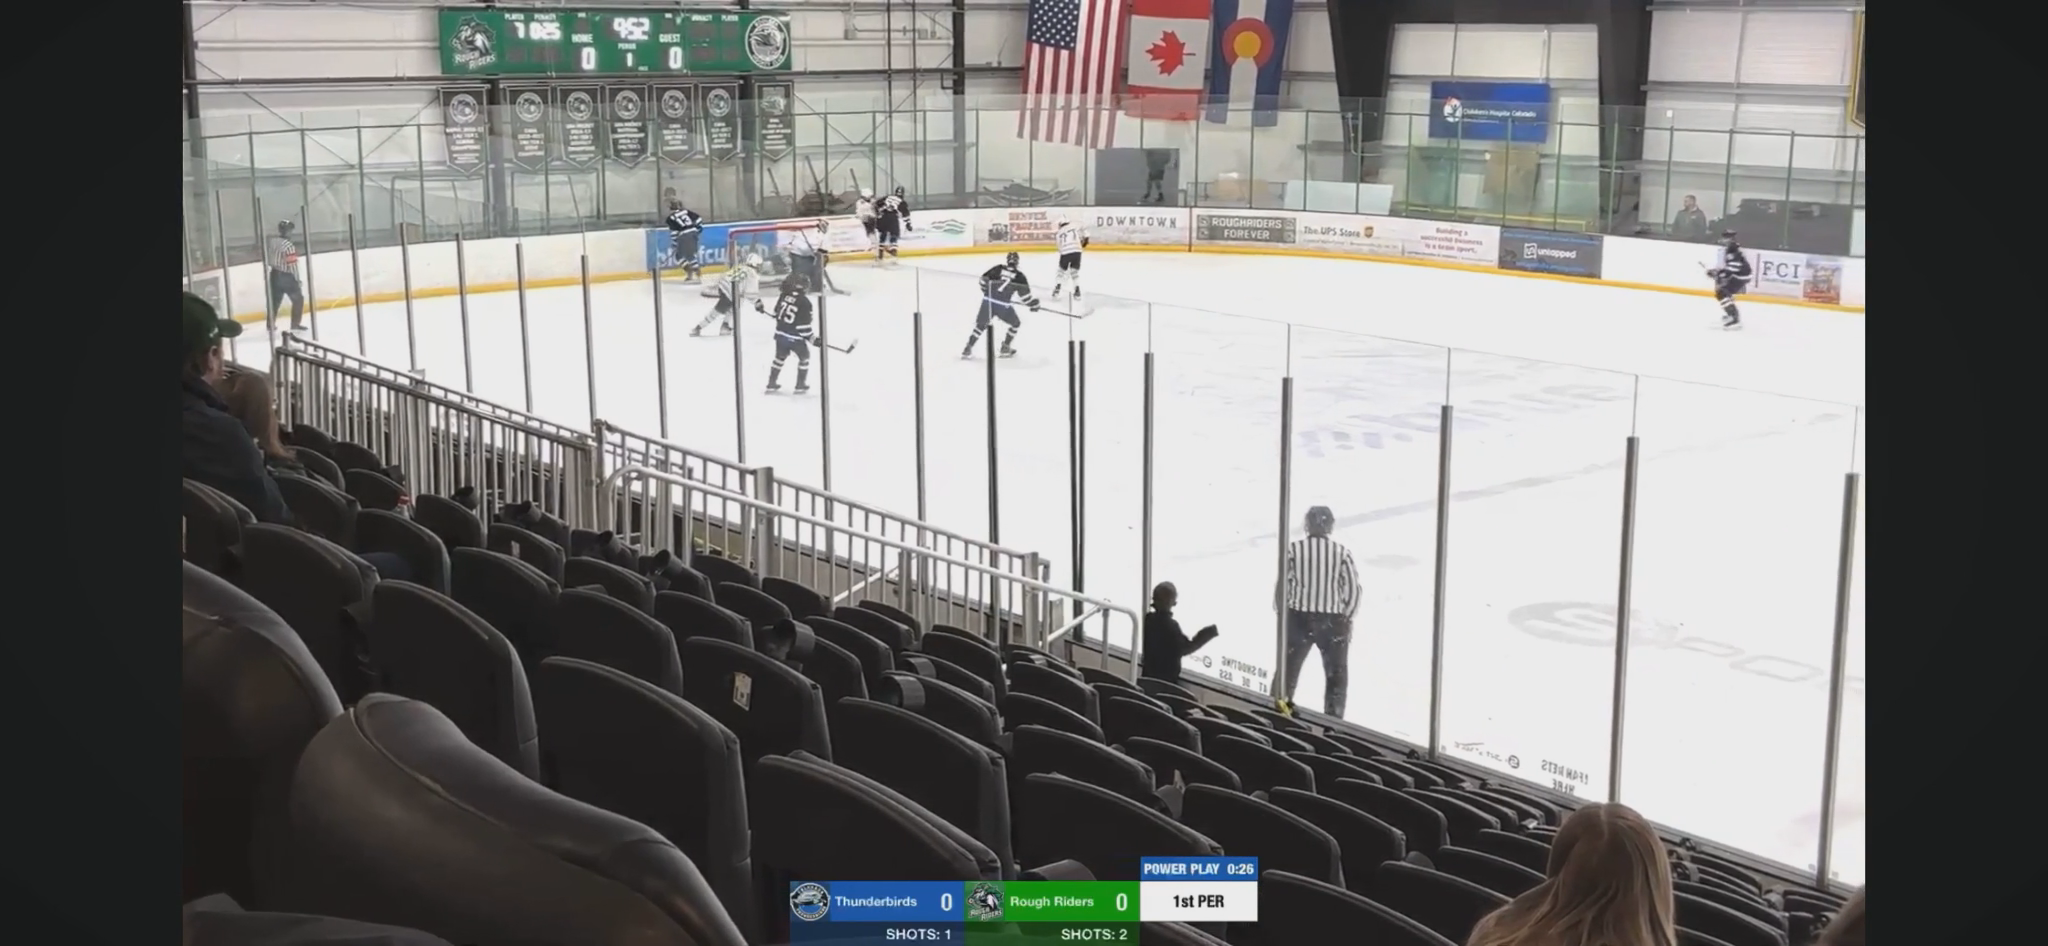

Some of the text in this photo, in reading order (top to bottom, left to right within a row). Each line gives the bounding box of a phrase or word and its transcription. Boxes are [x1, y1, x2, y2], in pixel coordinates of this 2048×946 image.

[659, 33, 681, 43] GUEST
[581, 47, 596, 70] 0
[626, 52, 633, 67] 1
[668, 46, 682, 69] 0
[1096, 215, 1177, 229] DOWNTOWN
[1211, 217, 1282, 229] ROUGHRIDERS
[1223, 229, 1270, 240] FOREVER
[1303, 226, 1361, 238] The UPS Store
[1435, 227, 1463, 237] Building
[1537, 248, 1577, 259] untapped
[1762, 260, 1801, 279] FCI
[998, 276, 1011, 292] 7
[778, 301, 799, 324] 75
